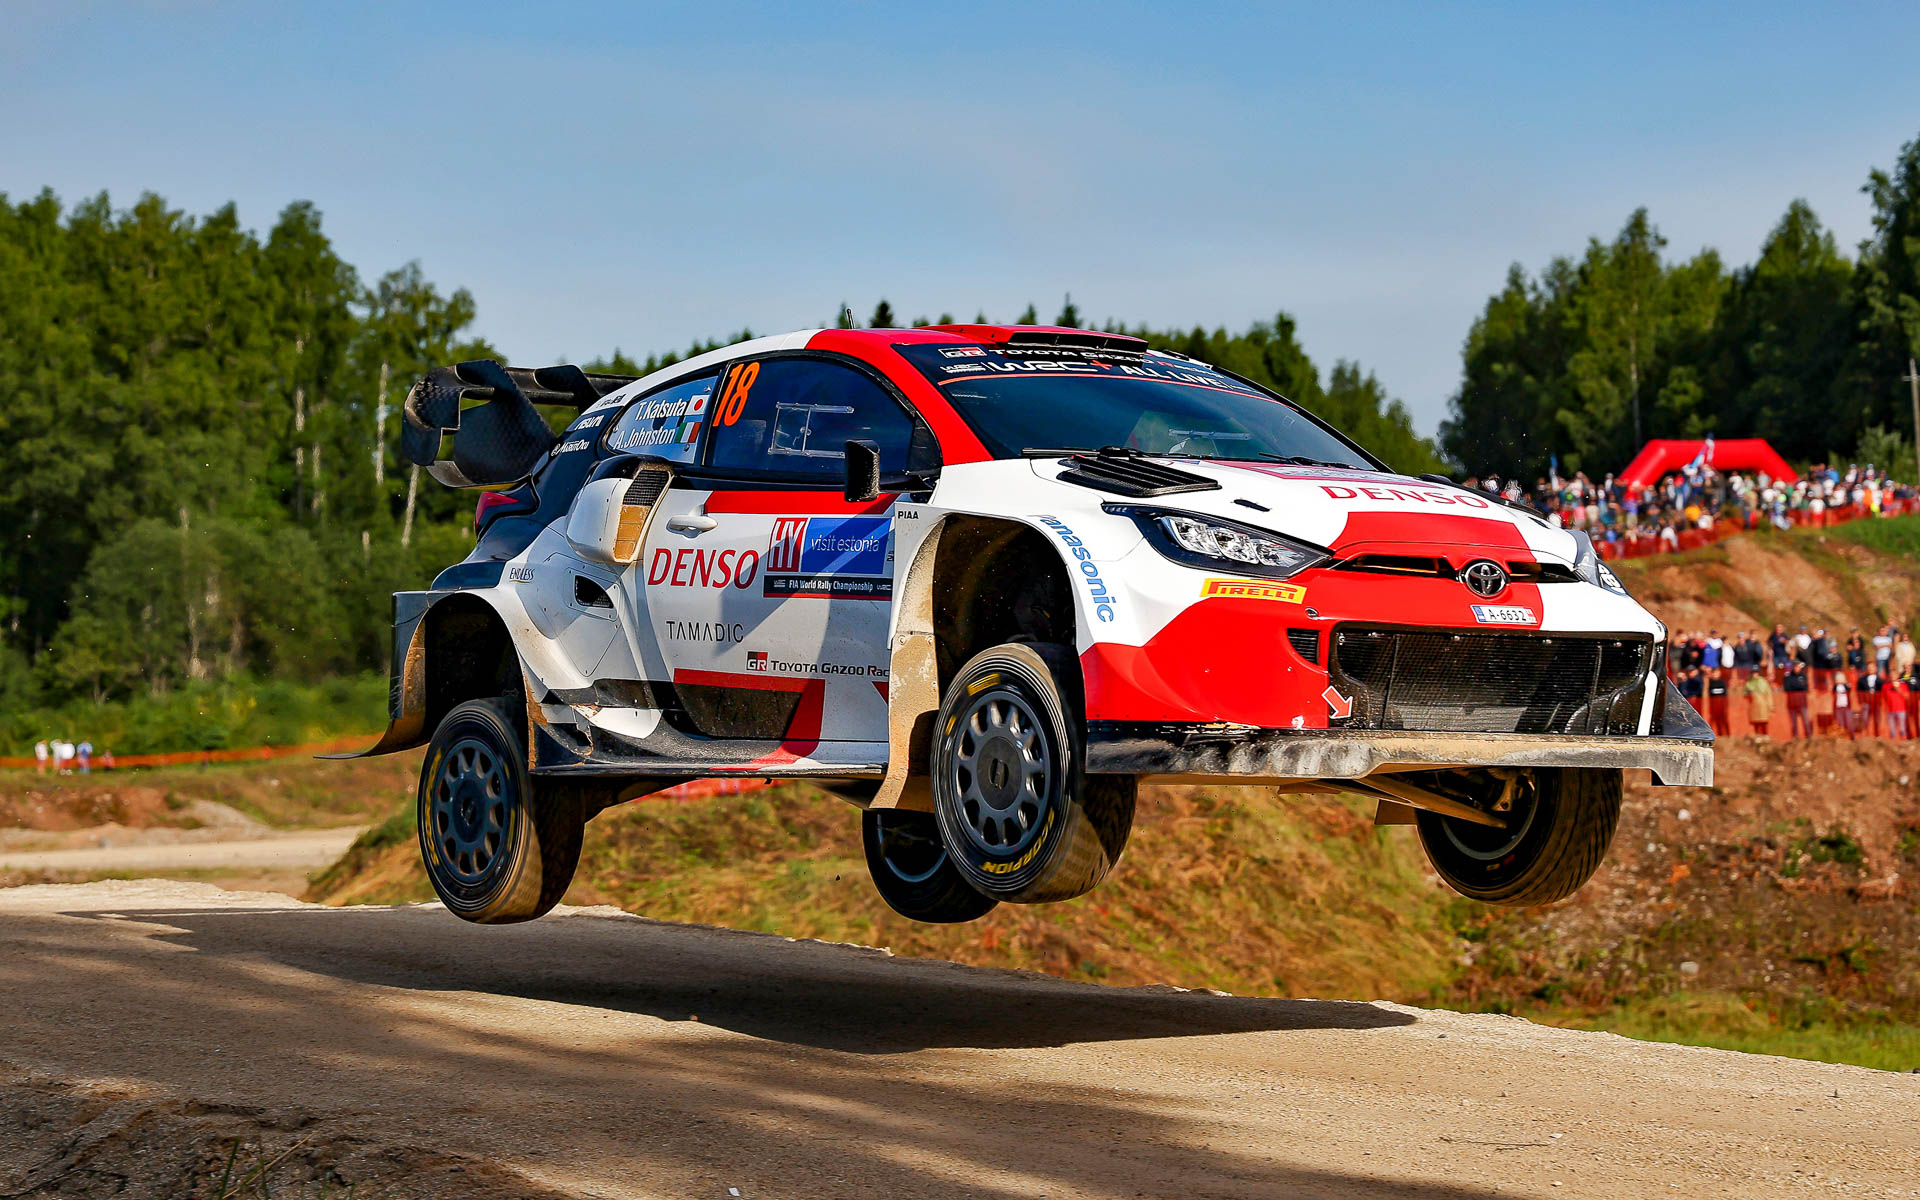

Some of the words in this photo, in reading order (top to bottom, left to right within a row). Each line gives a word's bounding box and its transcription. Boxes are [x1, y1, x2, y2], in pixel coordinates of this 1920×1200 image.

[989, 349, 1078, 357] TOYOTA
[712, 361, 761, 427] 18
[635, 398, 688, 421] T.Katsuta
[613, 426, 676, 450] A.Johnston
[1320, 485, 1489, 509] DENSO
[897, 510, 919, 520] PIAA
[811, 534, 836, 552] visit
[837, 535, 880, 552] estonia
[509, 568, 535, 580] ENDLESS
[647, 548, 760, 590] DENSO
[788, 580, 799, 589] FIA
[799, 580, 817, 590] World
[817, 580, 832, 591] Rally
[833, 581, 874, 593] Championship
[1208, 581, 1299, 601] PIRELLI
[1488, 608, 1527, 621] A-6632
[666, 621, 744, 643] TAMADIC
[747, 658, 768, 672] GR
[770, 660, 818, 674] TOYOTA
[821, 662, 865, 677] GAZOO
